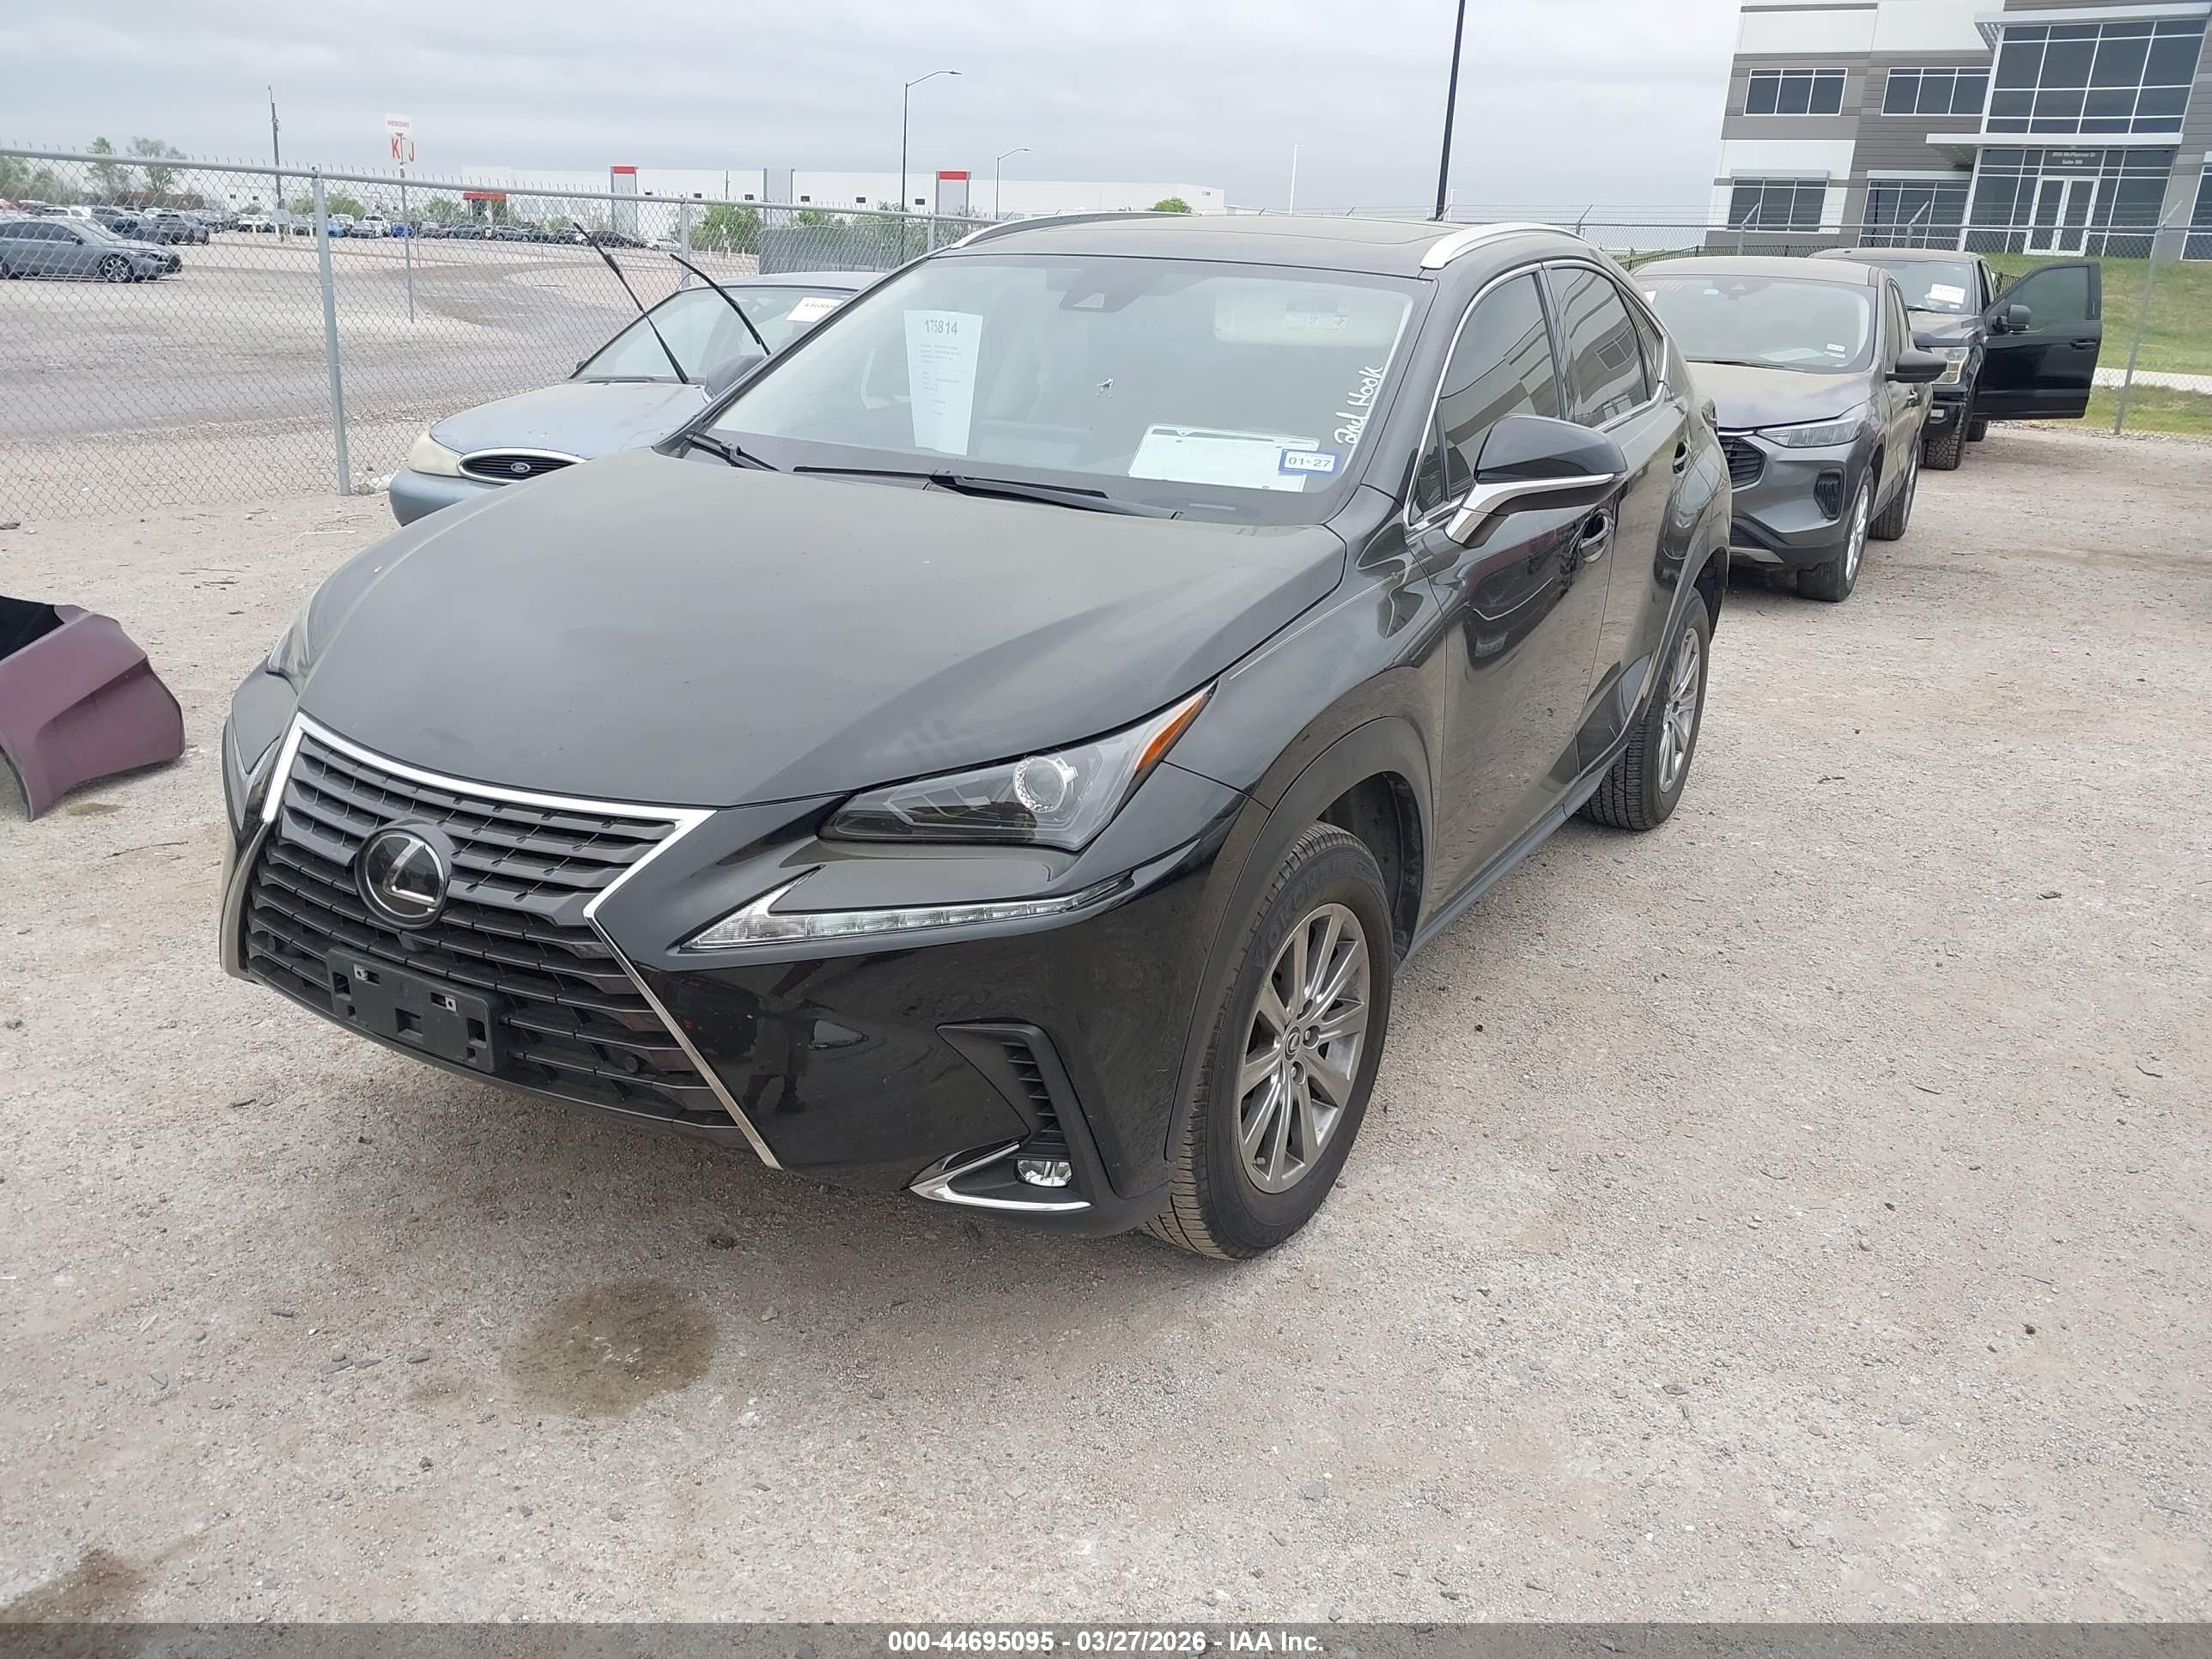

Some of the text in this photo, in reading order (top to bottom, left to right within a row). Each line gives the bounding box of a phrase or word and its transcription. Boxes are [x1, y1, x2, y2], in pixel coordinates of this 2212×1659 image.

[391, 137, 416, 163] K J
[924, 318, 959, 336] 175814
